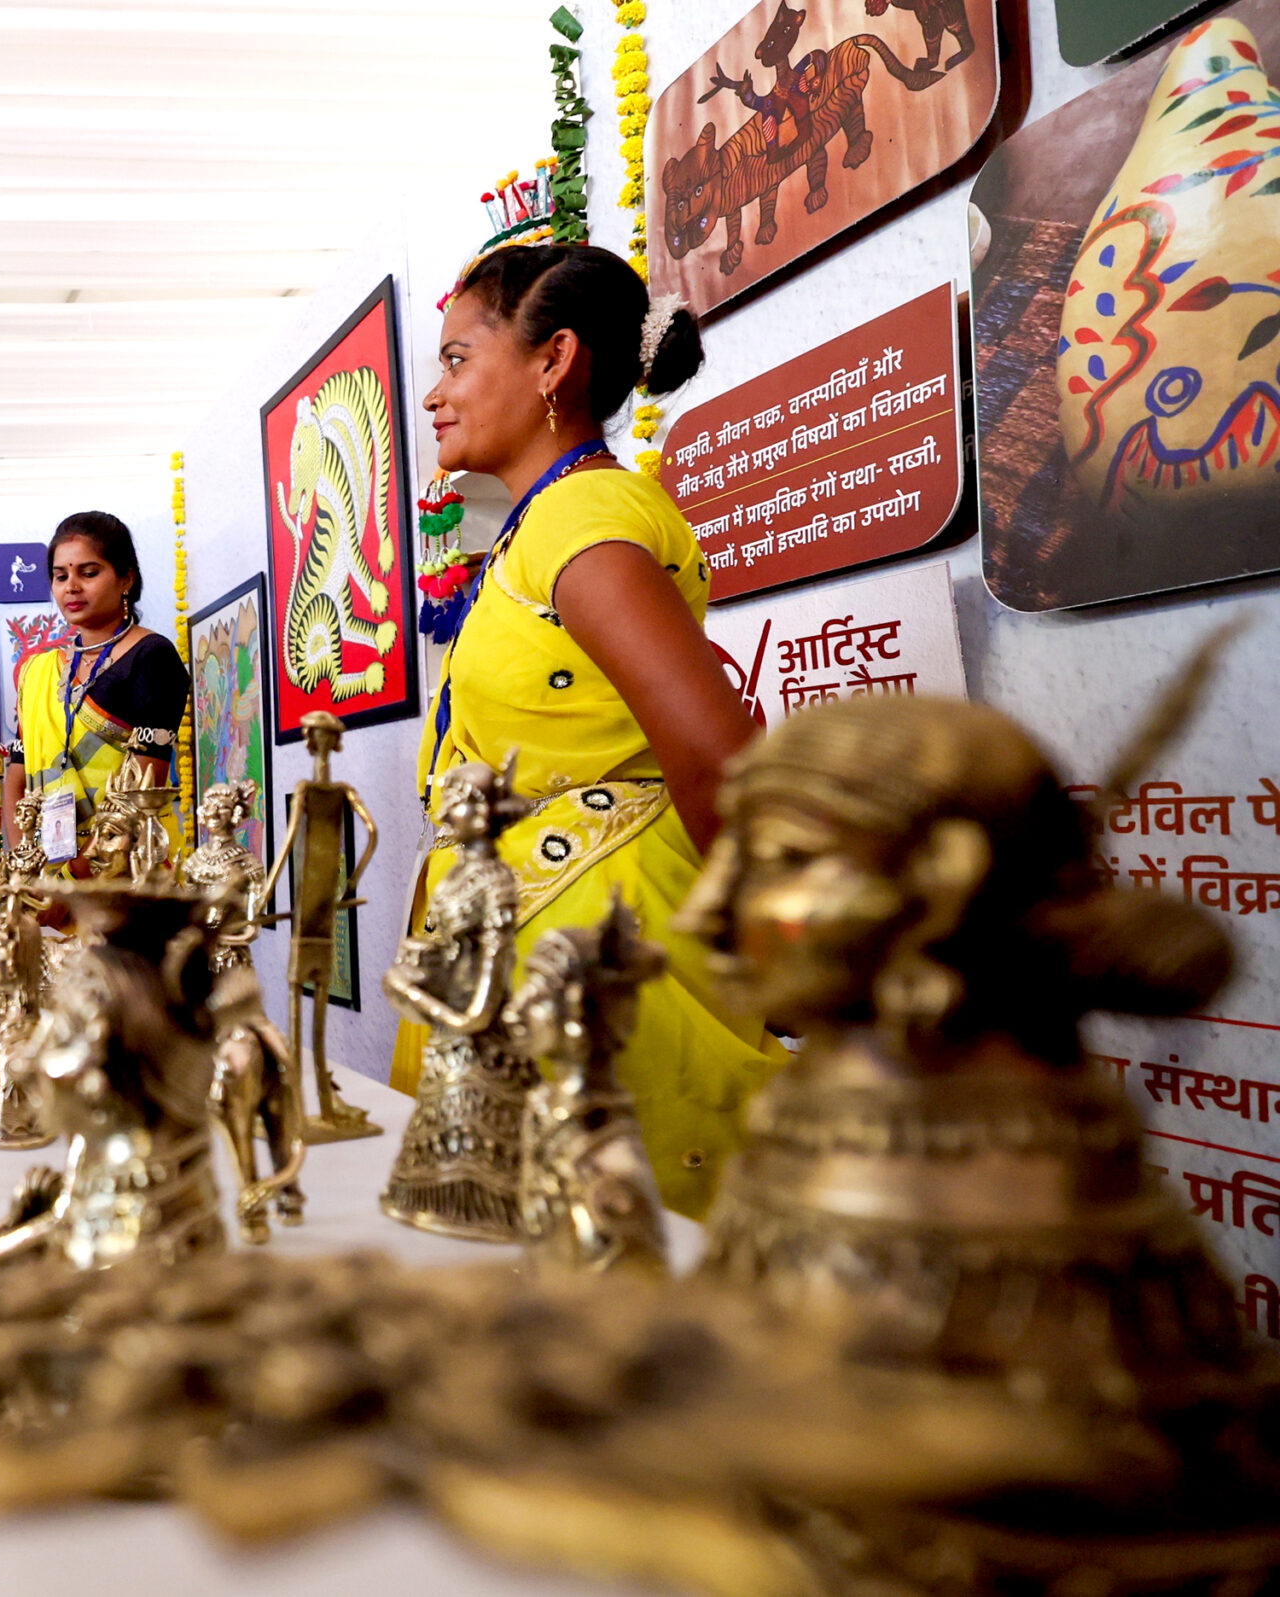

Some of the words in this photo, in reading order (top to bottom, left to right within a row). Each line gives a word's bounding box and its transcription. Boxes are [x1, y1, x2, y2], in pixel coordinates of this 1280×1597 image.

[676, 431, 713, 467] प्रकृति,
[716, 417, 751, 449] जीवन
[753, 404, 785, 431] चक्र,
[788, 358, 867, 415] वनस्पतियाँ
[872, 346, 904, 381] और
[676, 466, 725, 499] जीव-जंतु
[726, 450, 749, 480] जैसे
[752, 439, 788, 470] प्रमुख
[791, 413, 838, 453] विषयों
[842, 407, 867, 433] का
[870, 374, 948, 422] चित्रांकन
[732, 505, 744, 528] में
[746, 487, 808, 525] प्राकृतिक
[810, 471, 838, 501] रंगों
[840, 464, 884, 492] यथा-
[887, 435, 942, 476] सब्जी,
[741, 531, 775, 567] फूलों
[832, 510, 856, 534] का
[860, 489, 922, 526] उपयोग
[777, 615, 901, 673] आर्टिस्ट
